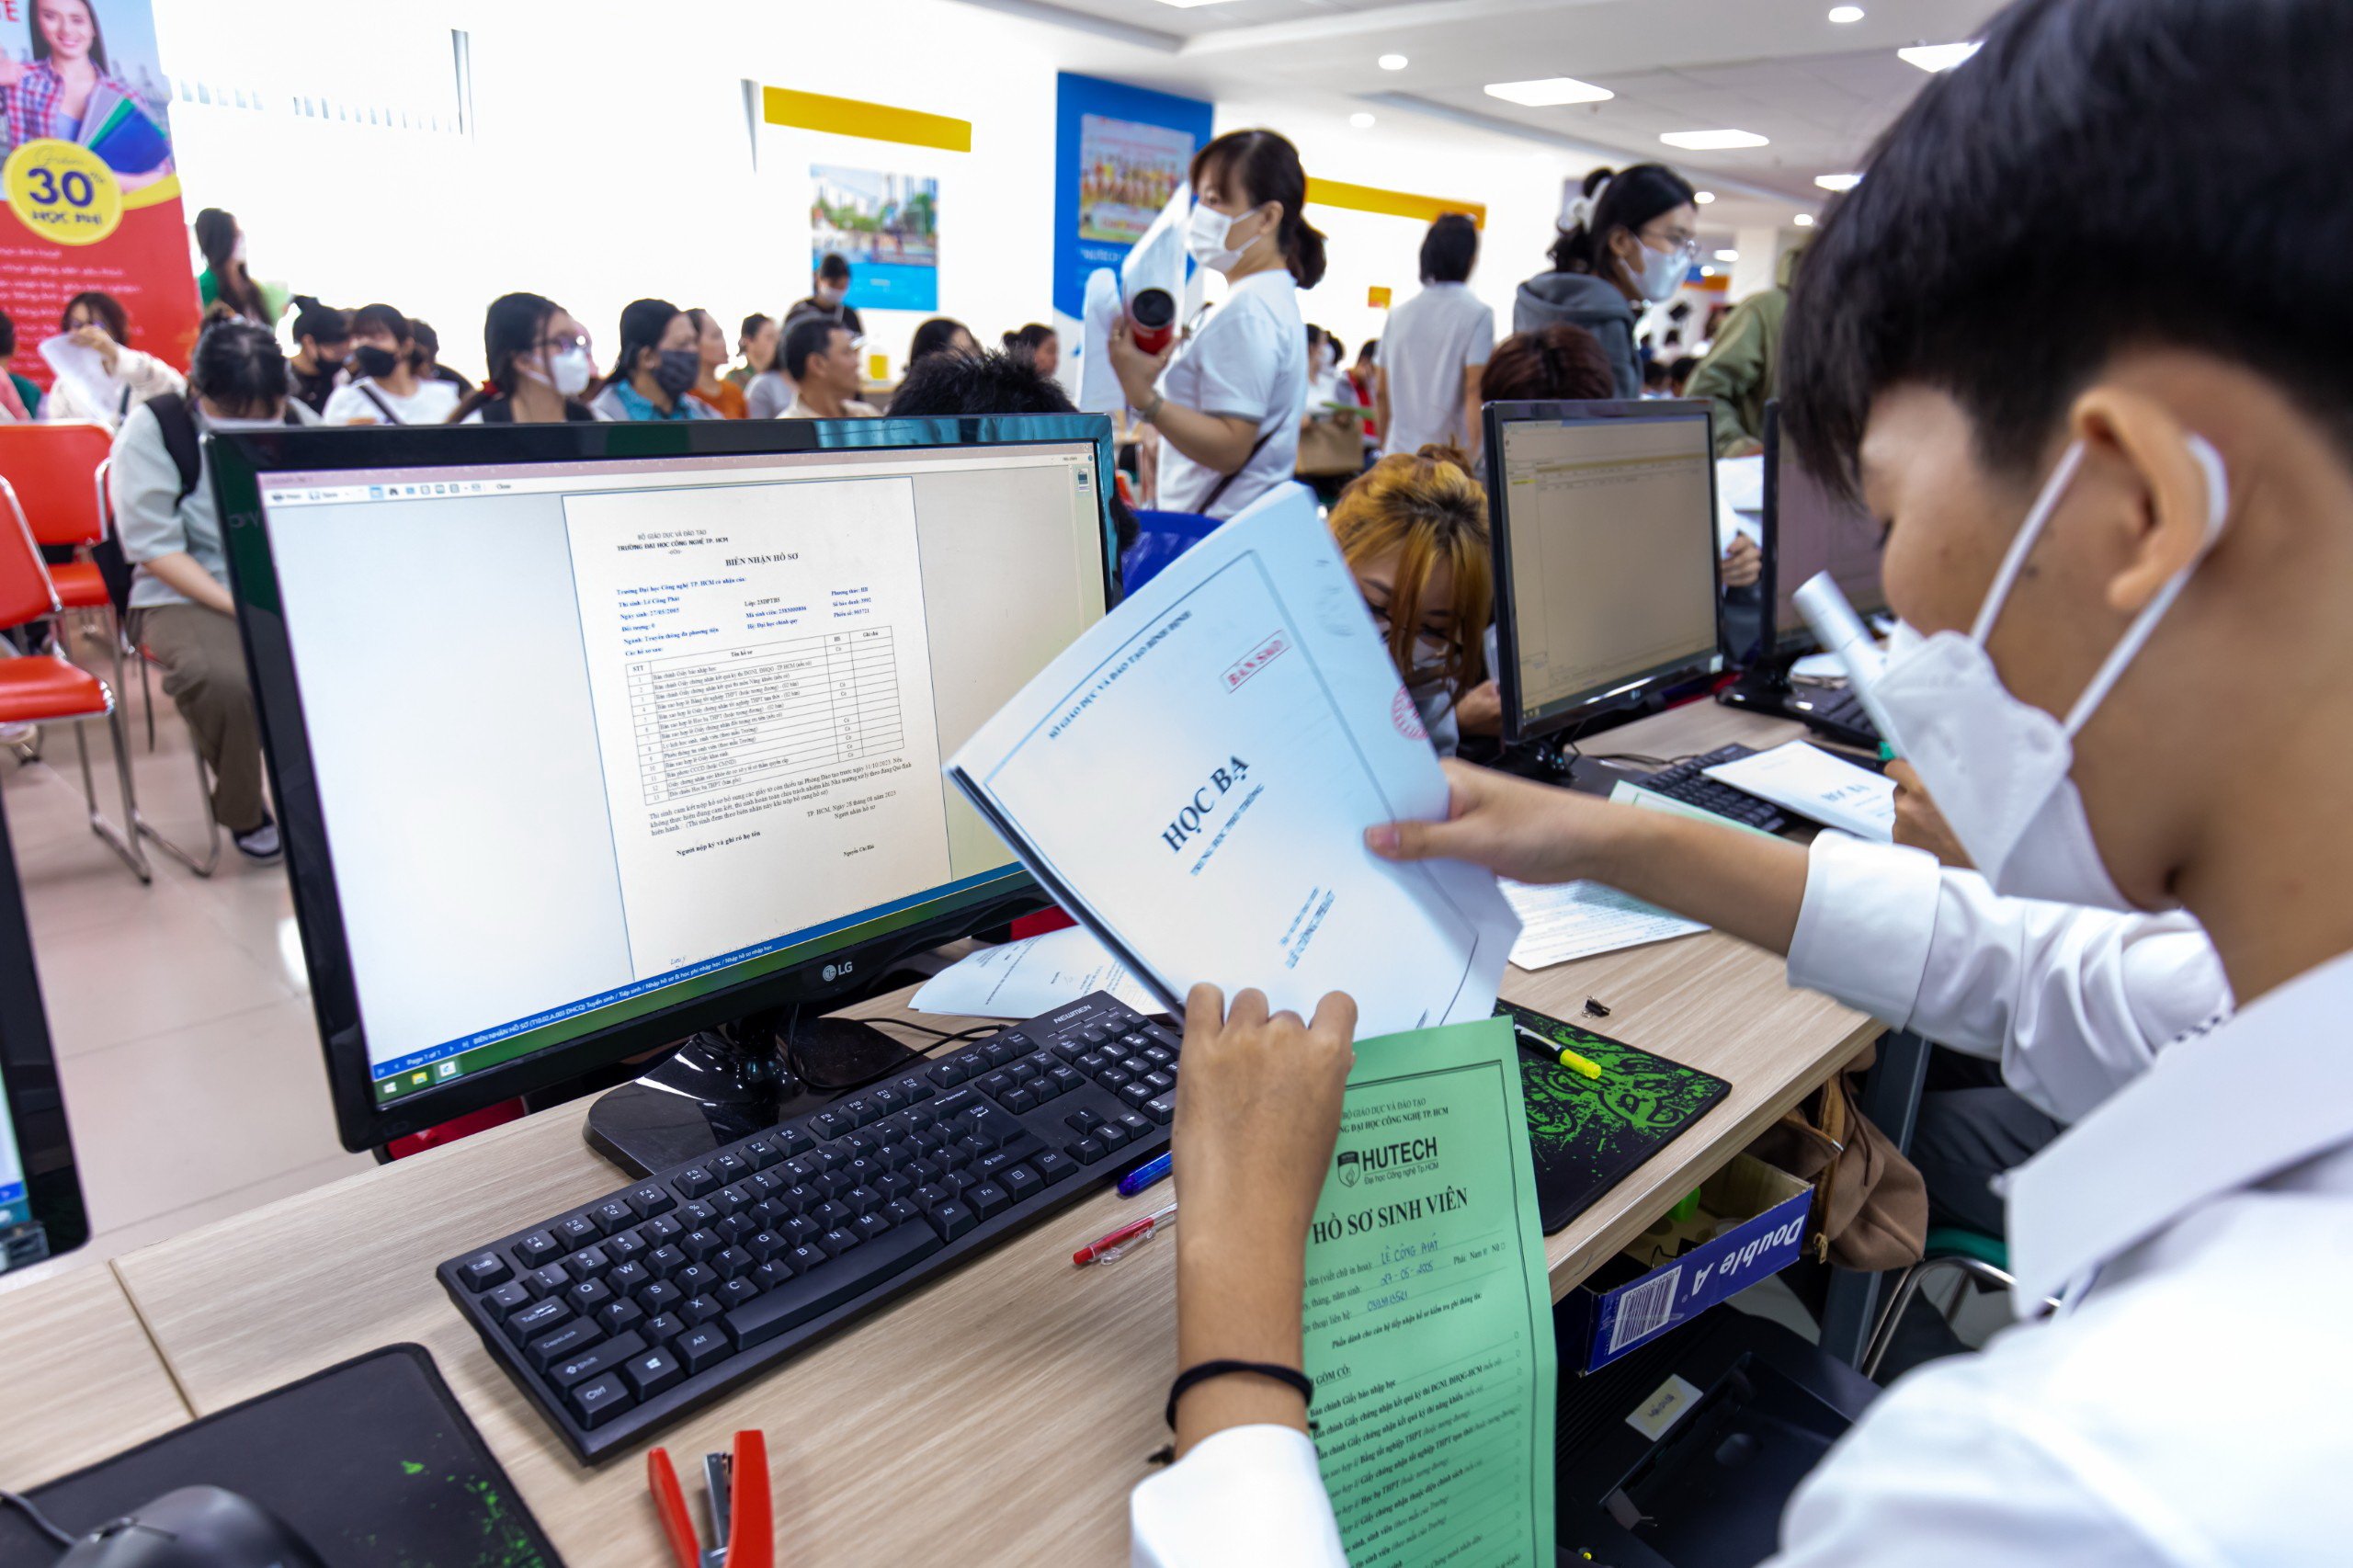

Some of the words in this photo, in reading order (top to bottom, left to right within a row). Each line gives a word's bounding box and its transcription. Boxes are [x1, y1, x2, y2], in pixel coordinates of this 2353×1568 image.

[28, 167, 95, 208] 30
[725, 556, 745, 566] BIÊN
[747, 555, 771, 563] NHẬN
[773, 552, 786, 562] HỒ
[1163, 787, 1214, 852] HỌC
[1211, 756, 1249, 795] BẠ
[837, 961, 853, 975] LG
[1054, 1005, 1092, 1024] NEWMEN
[1343, 1109, 1352, 1119] BỘ
[1353, 1107, 1370, 1118] GIÁO
[1370, 1104, 1385, 1115] DỤC
[1386, 1101, 1396, 1111] VÀ
[1397, 1099, 1412, 1109] ĐÀO
[1412, 1097, 1427, 1108] TẠO
[1350, 1122, 1364, 1132] ĐẠI
[1365, 1119, 1380, 1131] HỌC
[1381, 1115, 1402, 1126] CÔNG
[1402, 1111, 1421, 1121] NGHỆ
[1422, 1109, 1432, 1119] TP.
[1433, 1107, 1449, 1117] HCM
[1363, 1137, 1438, 1171] HUTECH
[1364, 1174, 1373, 1184] Đại
[1375, 1172, 1385, 1183] học
[1386, 1169, 1402, 1179] Công
[1403, 1166, 1416, 1177] nghệ
[1313, 1212, 1342, 1244] HỒ
[1347, 1208, 1373, 1235] SƠ
[1378, 1199, 1422, 1228] SINH
[1426, 1186, 1467, 1214] VIÊN
[1719, 1214, 1806, 1277] Double
[1690, 1262, 1715, 1297] A
[694, 1335, 707, 1346] Alt
[585, 1386, 606, 1400] Ctrl
